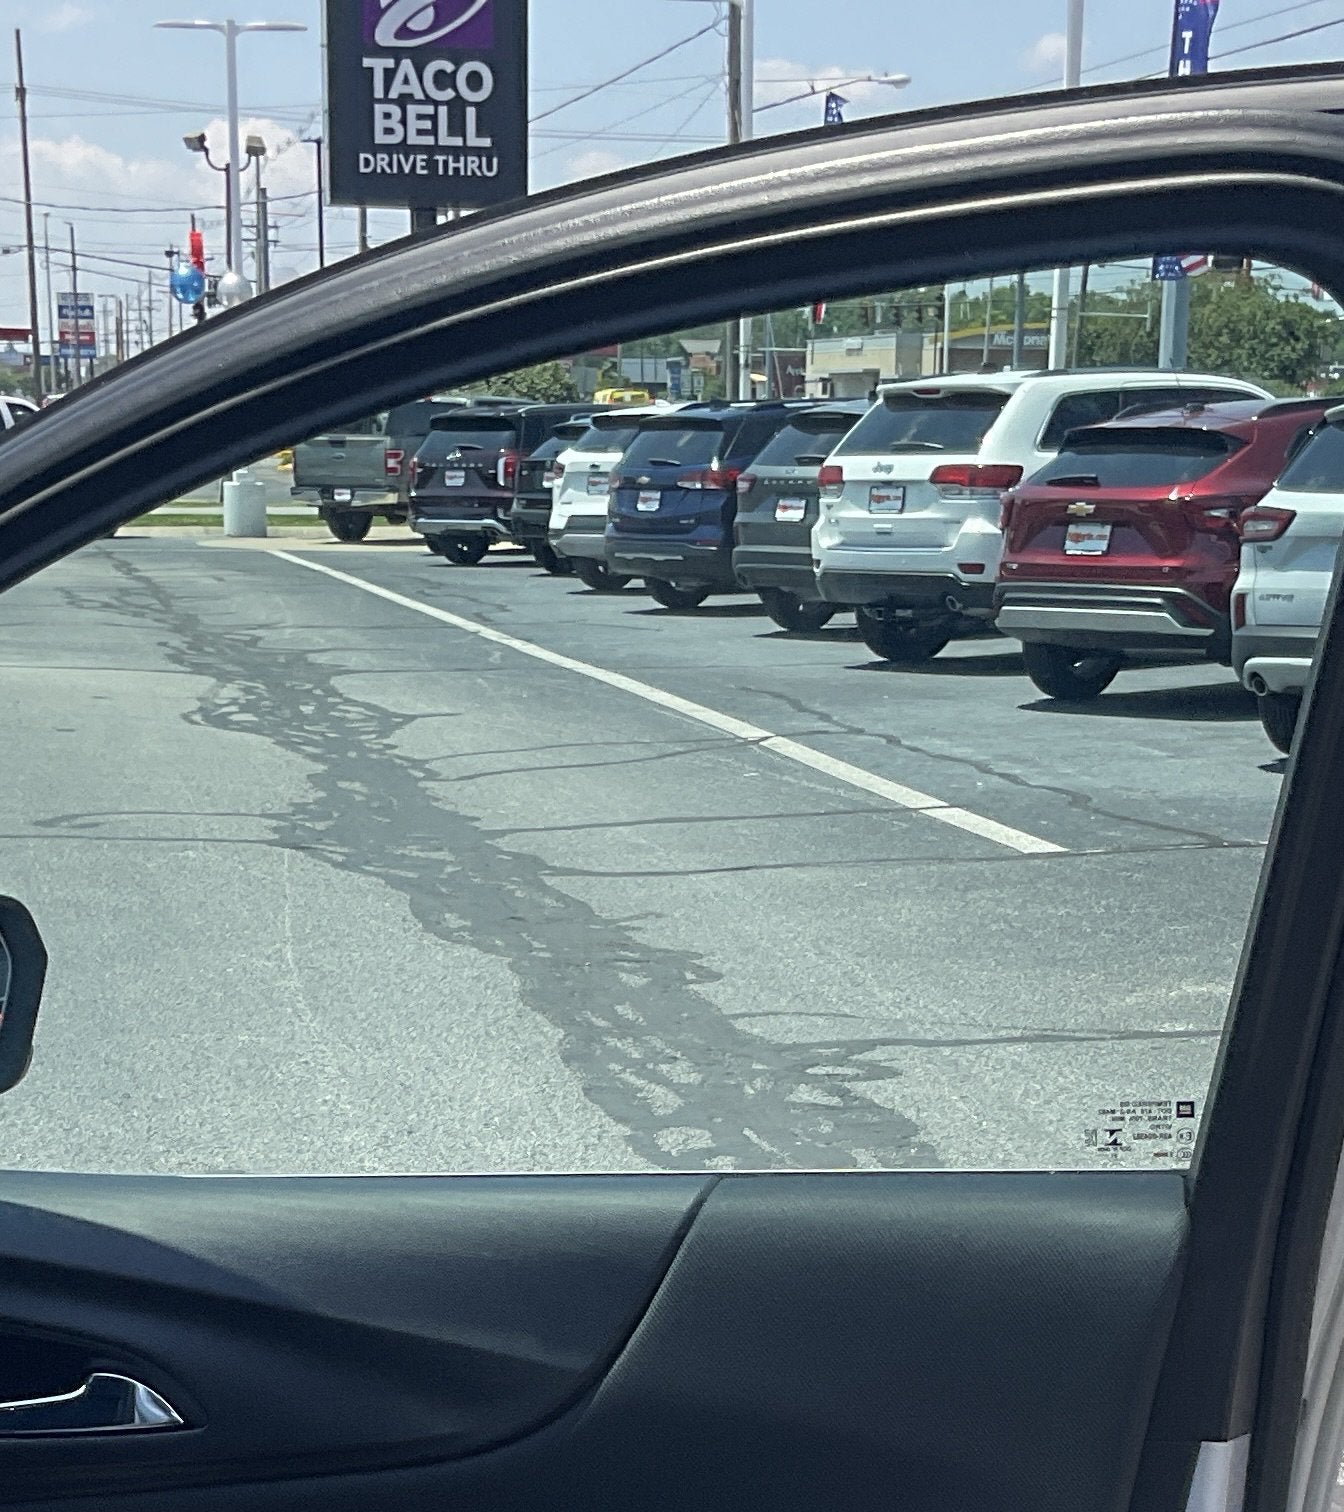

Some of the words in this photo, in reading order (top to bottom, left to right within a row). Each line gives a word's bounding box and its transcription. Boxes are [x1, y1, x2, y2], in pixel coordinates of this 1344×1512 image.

[362, 57, 494, 102] TACO
[374, 103, 492, 147] BELL
[359, 153, 428, 175] DRIVE
[433, 154, 498, 177] THRU
